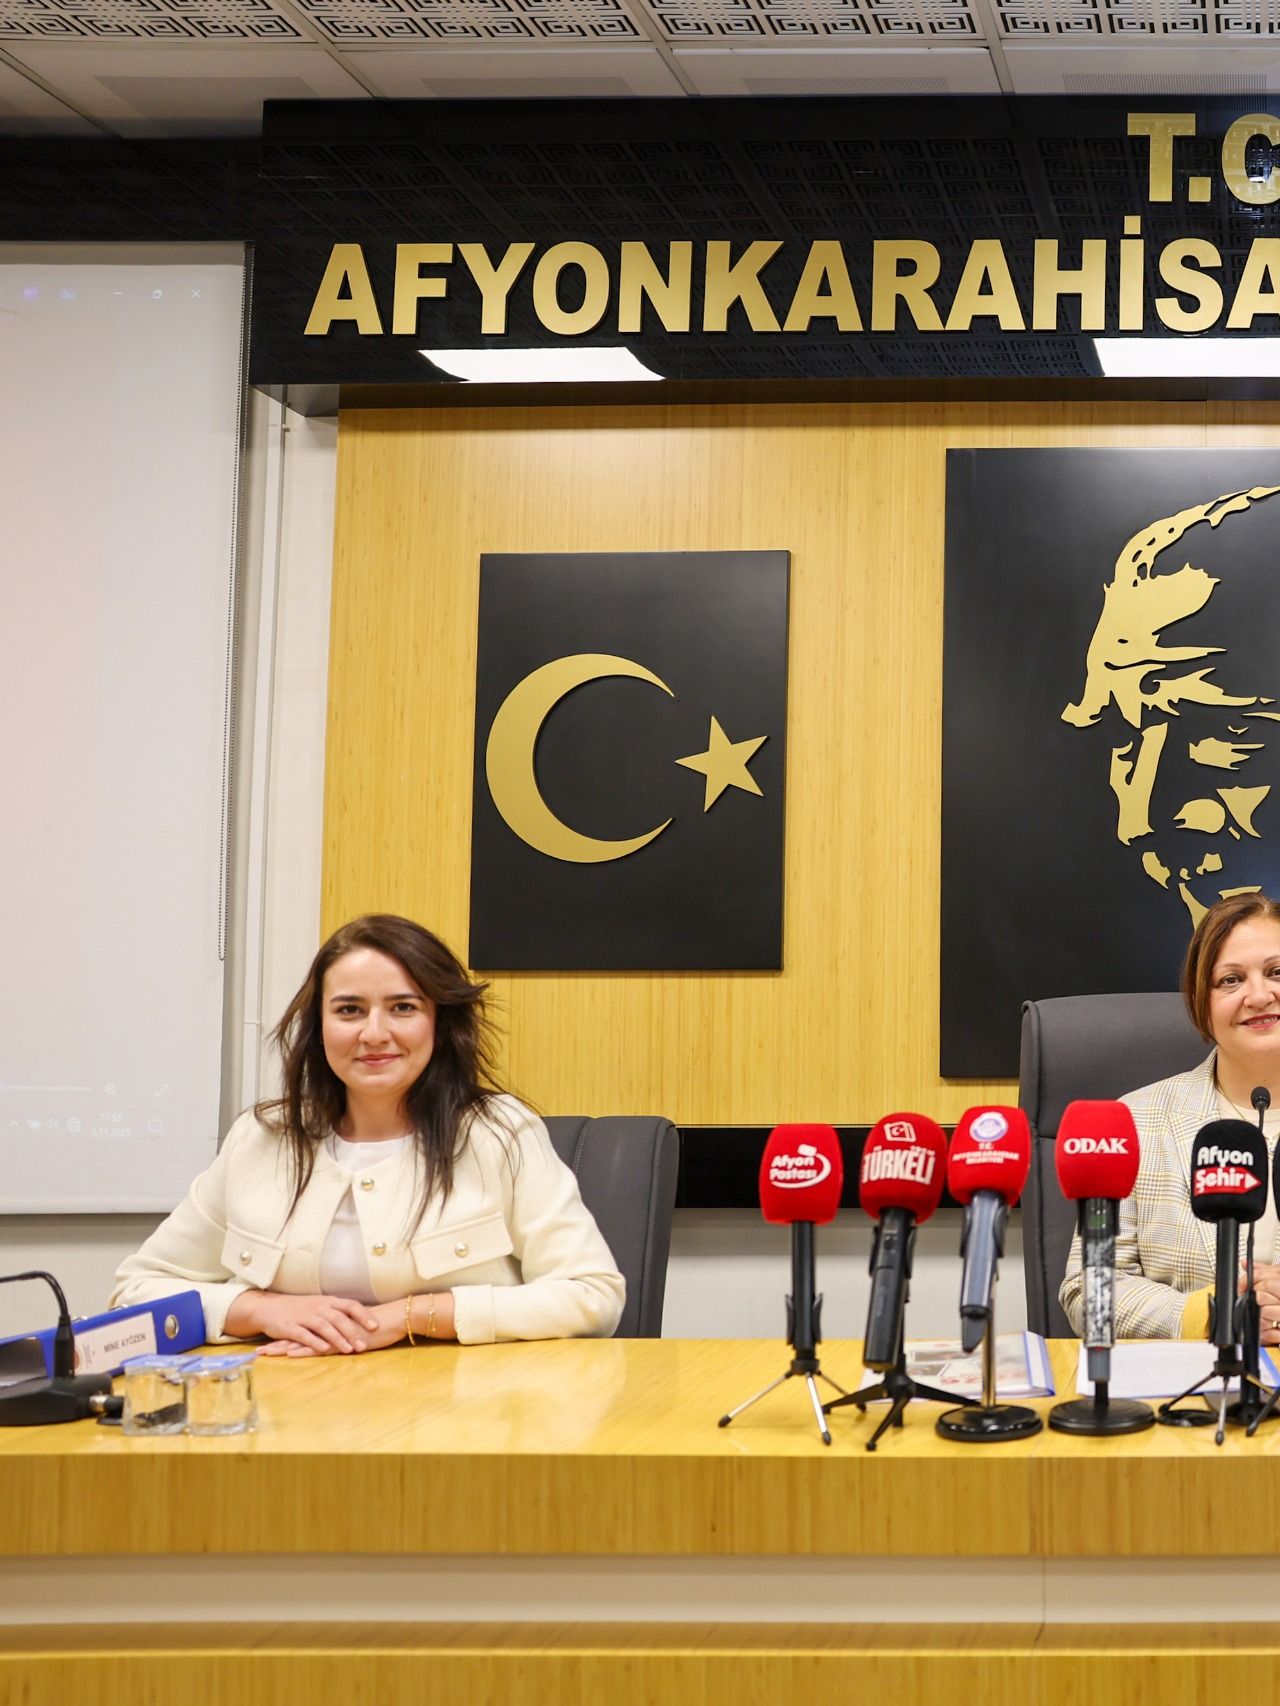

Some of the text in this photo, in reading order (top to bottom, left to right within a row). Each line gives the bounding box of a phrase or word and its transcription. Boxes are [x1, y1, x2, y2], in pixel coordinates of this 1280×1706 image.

[1064, 1138, 1129, 1155] ODAK
[1197, 1145, 1254, 1168] Afyon
[771, 1154, 815, 1170] Afyon
[1195, 1167, 1245, 1194] Şehir
